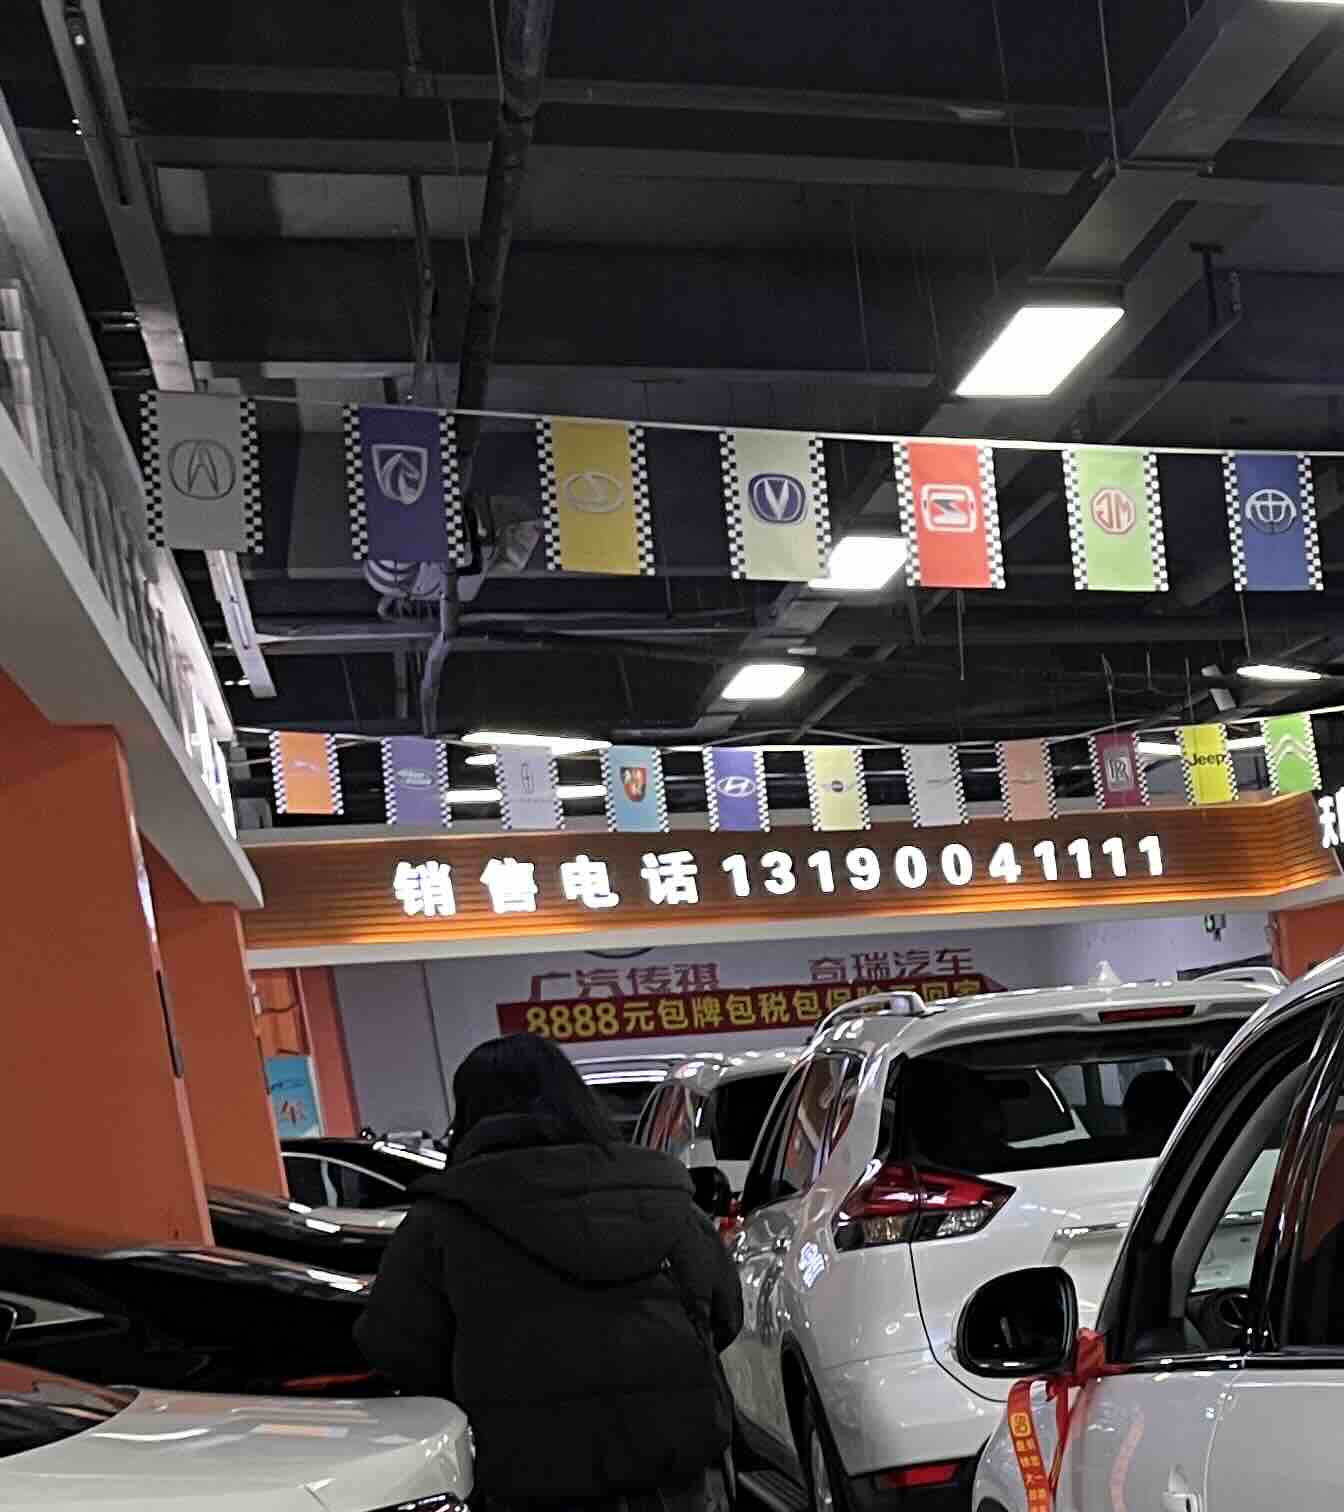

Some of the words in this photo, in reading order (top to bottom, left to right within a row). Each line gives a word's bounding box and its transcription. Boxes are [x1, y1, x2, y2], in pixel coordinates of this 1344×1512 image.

[1188, 753, 1227, 767] Jeep
[808, 947, 975, 982] 奇瑞汽车
